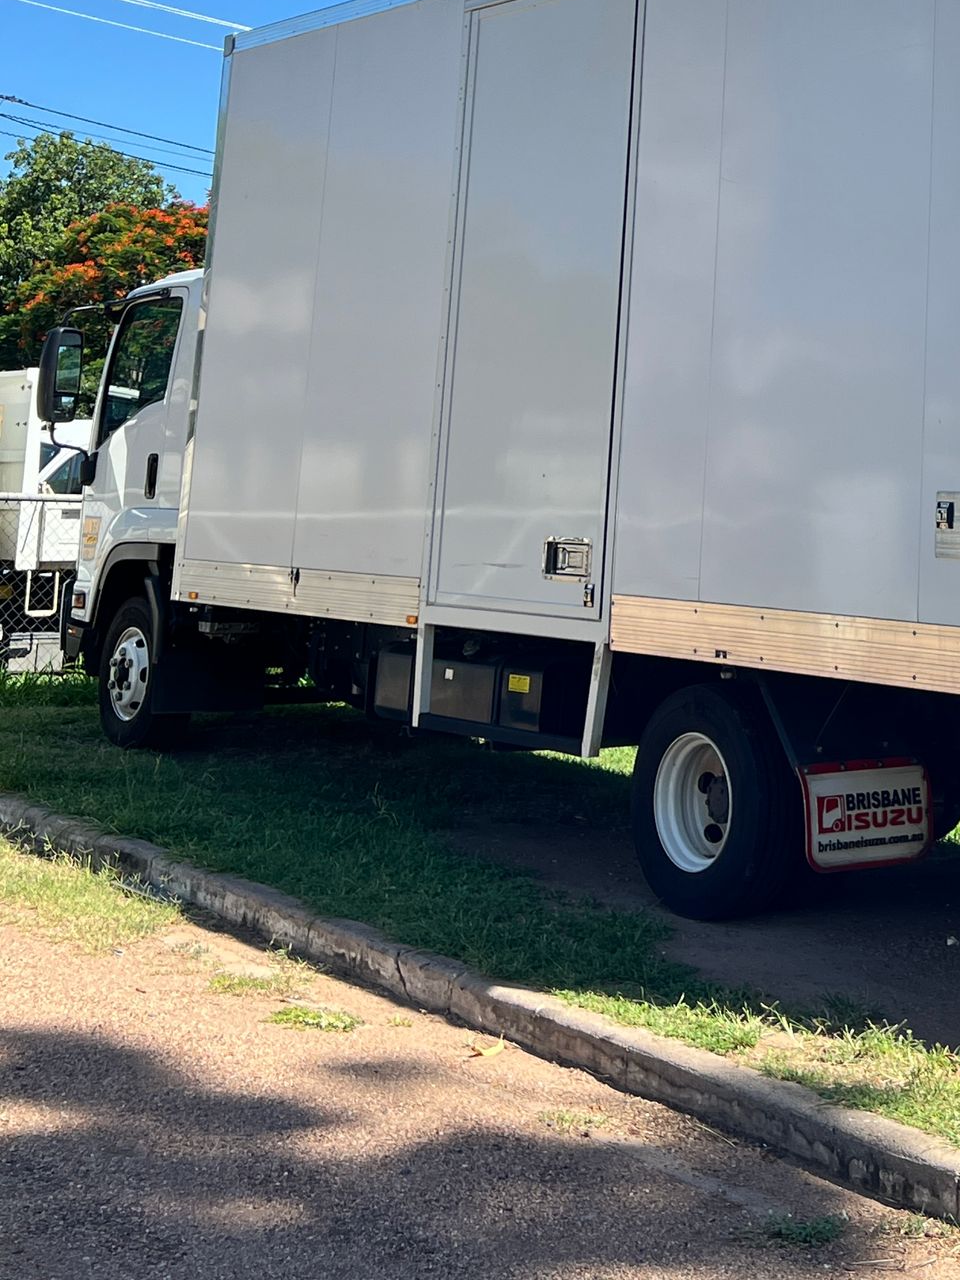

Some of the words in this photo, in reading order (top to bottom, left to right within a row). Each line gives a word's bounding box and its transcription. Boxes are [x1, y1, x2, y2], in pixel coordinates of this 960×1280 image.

[845, 787, 922, 811] BRISBANE
[846, 806, 923, 831] ISUZU
[818, 833, 924, 853] brisbaneisuzu.com.au
